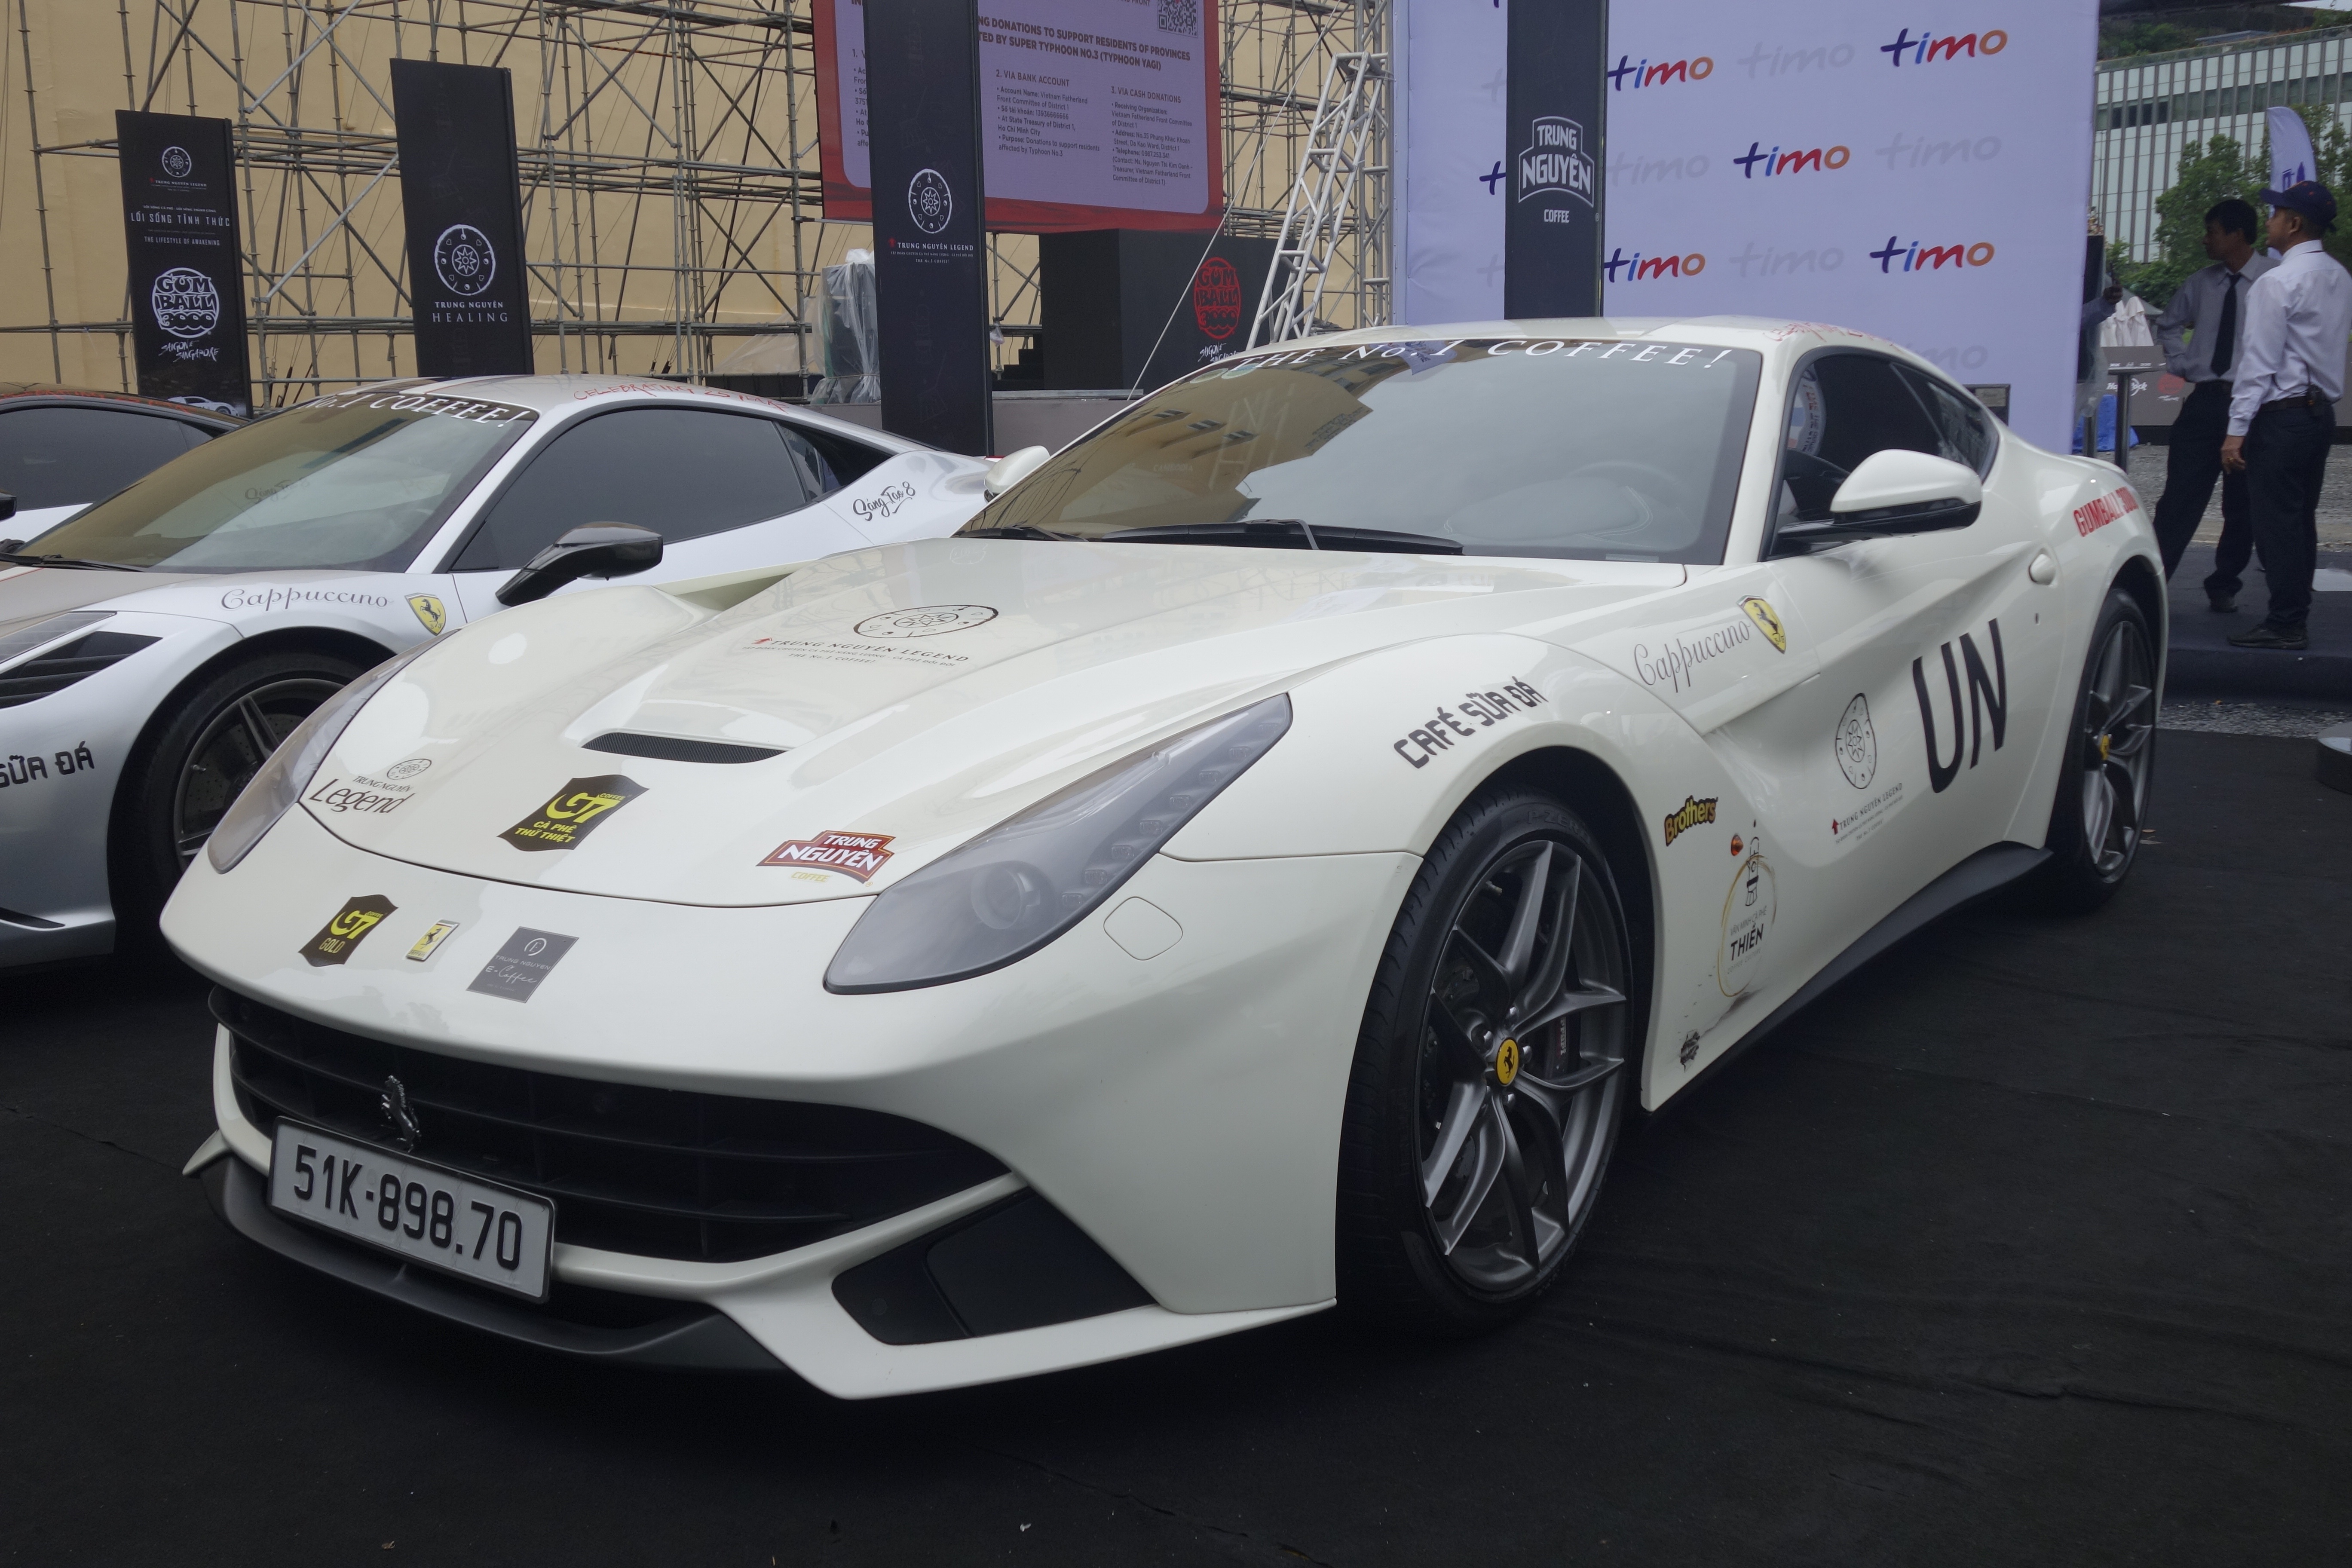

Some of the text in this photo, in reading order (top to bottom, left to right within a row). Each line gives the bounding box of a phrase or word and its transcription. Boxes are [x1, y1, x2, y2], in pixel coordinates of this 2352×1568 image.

[992, 18, 1041, 35] DONATIONS
[1044, 27, 1054, 37] TO
[1057, 29, 1093, 43] SUPPORT
[1096, 36, 1137, 52] RESIDENTS
[1139, 43, 1148, 53] OF
[1150, 46, 1190, 61] PROVINCES
[996, 35, 1006, 44] BY
[1009, 36, 1036, 49] SUPER
[1039, 42, 1078, 56] TYPHOON
[1080, 48, 1099, 60] NO.3
[1100, 52, 1139, 67] (TYPHOON
[1141, 58, 1161, 71] YAGI)
[1880, 28, 2007, 67] timo
[1607, 55, 1714, 91] timo
[1737, 41, 1855, 80] timo
[1004, 70, 1016, 79] VIA
[1018, 73, 1036, 83] BANK
[1038, 76, 1069, 87] ACCOUNT
[1001, 86, 1087, 104] Account Name: Vietnam Fatherland
[1013, 97, 1040, 106] Committee
[1115, 101, 1167, 115] Receiving Organization:
[1118, 87, 1128, 95] VIA
[1130, 89, 1145, 98] CASH
[1148, 92, 1181, 103] DONATIONS
[1024, 118, 1044, 127] Treasury
[1112, 110, 1130, 119] Vietnam
[1132, 113, 1155, 122] Fatherland
[1169, 118, 1192, 126] Committee
[1002, 135, 1025, 143] Purpose:
[1026, 137, 1051, 146] Donations
[1537, 125, 1577, 150] TRUNG
[1875, 132, 2001, 170] timo
[1029, 147, 1050, 156] Typhoon
[1733, 141, 1850, 178] timo
[1522, 153, 1590, 194] NGUYÊN
[1608, 151, 1710, 188] timo
[131, 211, 230, 226] LỐI SỐNG THỨC
[1544, 209, 1569, 223] COFFEE
[1604, 247, 1705, 283] timo
[1729, 241, 1843, 278] timo
[1870, 235, 1995, 273] timo
[156, 274, 216, 294] GUM
[1197, 265, 1237, 288] GUM
[154, 294, 216, 312] BALL
[432, 312, 508, 322] HEALING
[1232, 348, 1326, 371] THE
[1487, 340, 1732, 369] COFFEE!
[370, 395, 530, 428] COFFEE!
[853, 481, 916, 521] Sáng Tạo 8
[221, 587, 394, 612] Cappuccino
[827, 643, 897, 652] NGUYÊN
[901, 649, 969, 662] LEGEND
[1634, 621, 1751, 693] Cappuccino
[1913, 618, 2007, 793] UN
[1394, 676, 1549, 769] CAFÉ SỮA ĐÁ
[55, 741, 95, 775] ĐÁ
[309, 779, 415, 813] Legend
[546, 792, 622, 823] G7
[551, 824, 577, 833] PHÊ
[1664, 795, 1716, 847] Brothers
[515, 828, 576, 843] THỨ THIỆT
[824, 835, 882, 849] TRUNG
[778, 844, 883, 871] NGUYÊN
[791, 872, 831, 882] COFFEE
[331, 910, 380, 939] G7
[319, 937, 346, 953] GOLD
[495, 955, 519, 964] TRUNG
[294, 1144, 522, 1271] 51K-898.70
